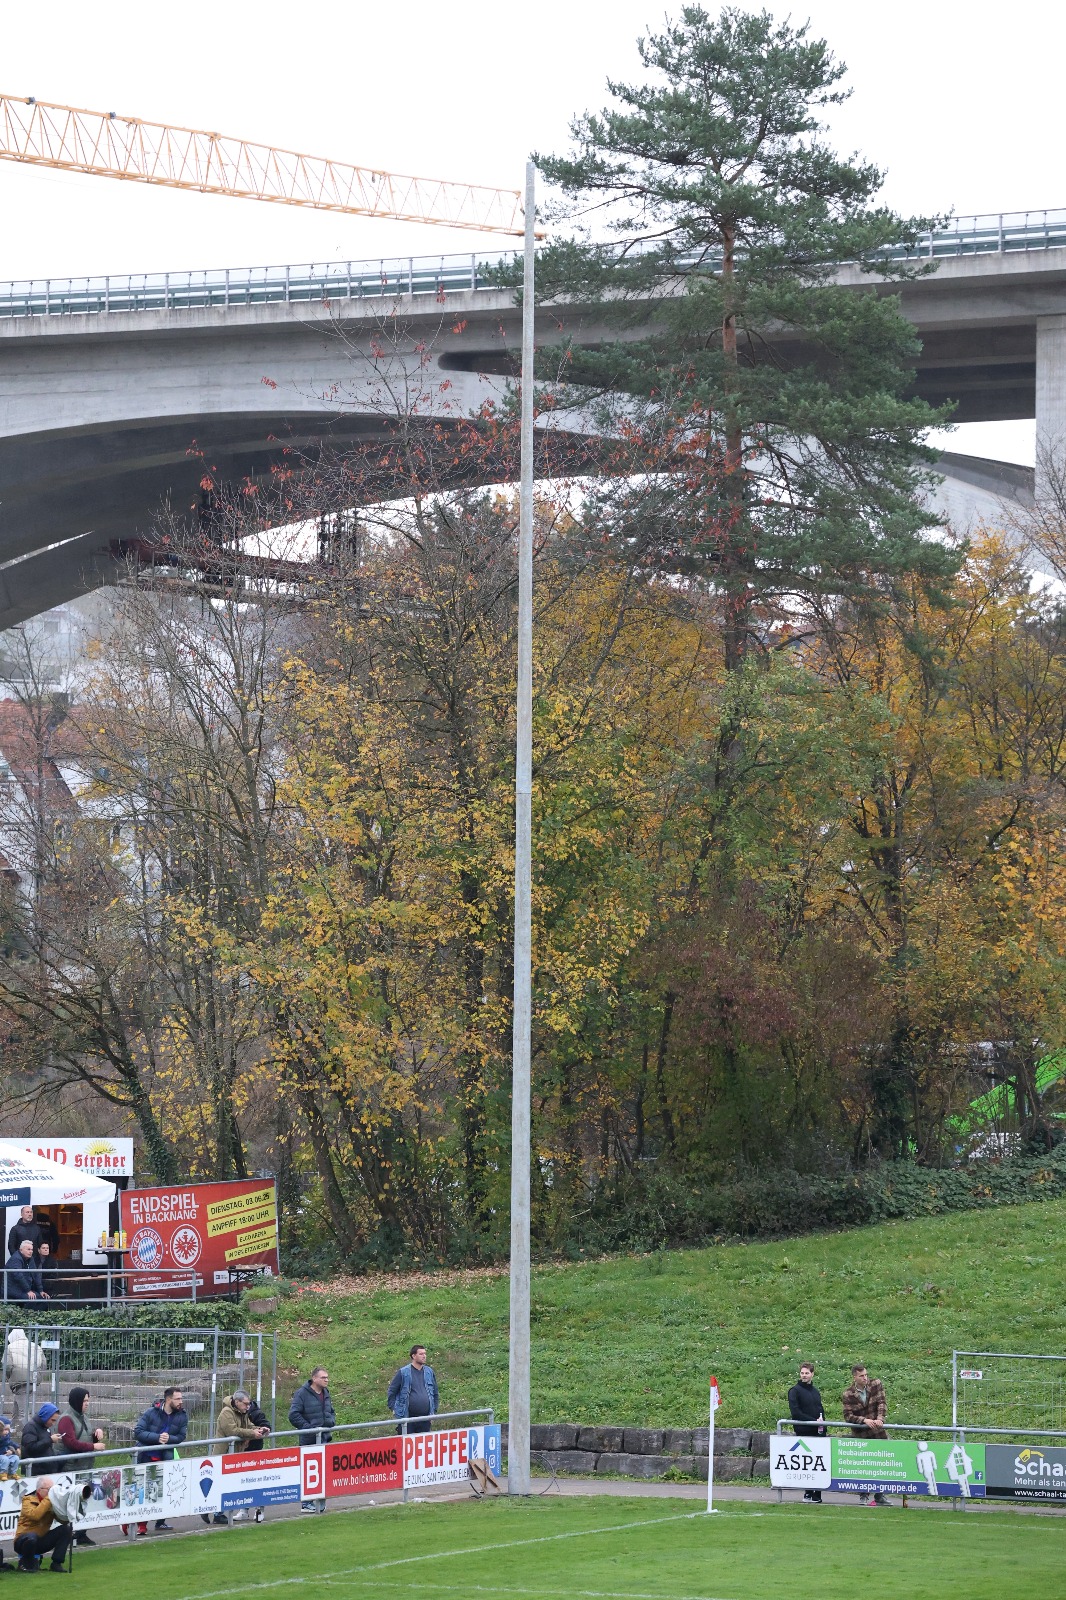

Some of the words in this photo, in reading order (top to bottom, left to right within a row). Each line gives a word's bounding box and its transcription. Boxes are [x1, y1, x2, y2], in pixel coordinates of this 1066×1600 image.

[74, 1154, 126, 1168] Streker
[130, 1193, 199, 1214] ENDSPIEL
[210, 1200, 245, 1215] DIENSTAG,
[133, 1213, 143, 1225] IN
[146, 1209, 197, 1224] BACKNANG
[212, 1218, 238, 1232] ANPFIFF
[256, 1209, 270, 1220] UHR
[139, 1229, 161, 1246] BAYERN
[404, 1429, 479, 1472] PFEIFFER
[838, 1440, 868, 1448] Bauträger
[332, 1449, 398, 1472] BOLCKMANS
[838, 1449, 895, 1458] Neubauimmobilien
[775, 1454, 827, 1471] ASPA
[838, 1459, 903, 1467] Gebrauchtimmobilien
[1014, 1456, 1066, 1477] Scha
[306, 1460, 320, 1489] B
[332, 1470, 398, 1488] www.bolckmans.de
[838, 1467, 907, 1478] Finanzierungsberatung
[838, 1482, 917, 1493] www.aspa-gruppe.de
[1014, 1477, 1036, 1485] Mehr
[1038, 1478, 1050, 1486] als
